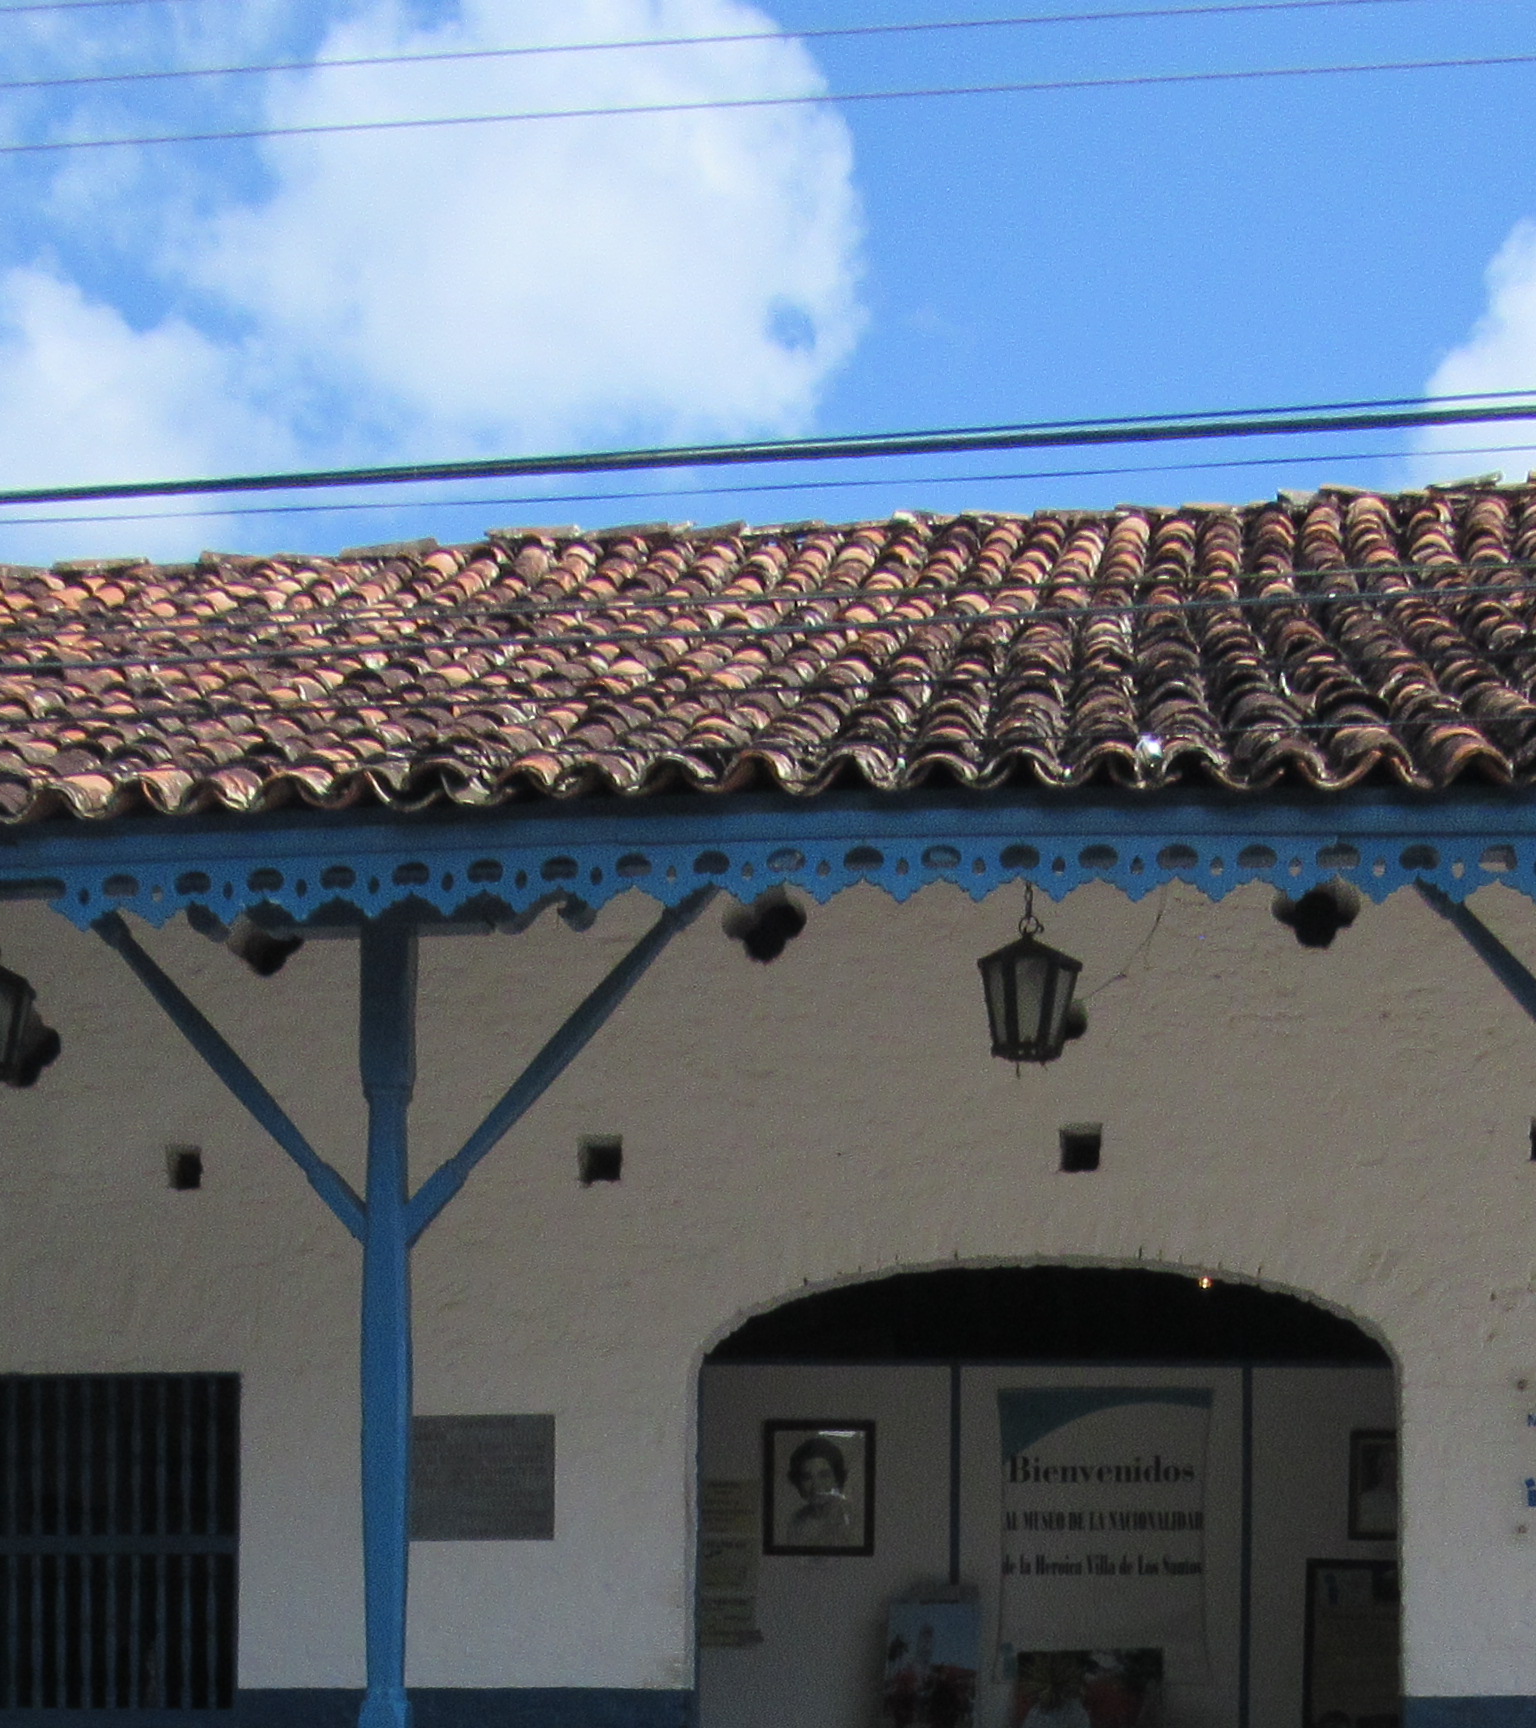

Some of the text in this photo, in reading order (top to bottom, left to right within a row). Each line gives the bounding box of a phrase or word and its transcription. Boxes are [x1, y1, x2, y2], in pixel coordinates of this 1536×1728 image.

[1008, 1455, 1195, 1483] Bienvenidos
[1023, 1511, 1065, 1531] MUSEO
[1068, 1511, 1084, 1531] DE
[1089, 1511, 1105, 1531] LA
[1109, 1511, 1205, 1531] NACIONALIDAD
[1020, 1554, 1031, 1575] la
[1035, 1554, 1083, 1575] Heroica
[1086, 1554, 1116, 1575] Villa
[1119, 1554, 1134, 1575] de
[1137, 1554, 1159, 1575] Los
[1162, 1556, 1203, 1575] Santos
